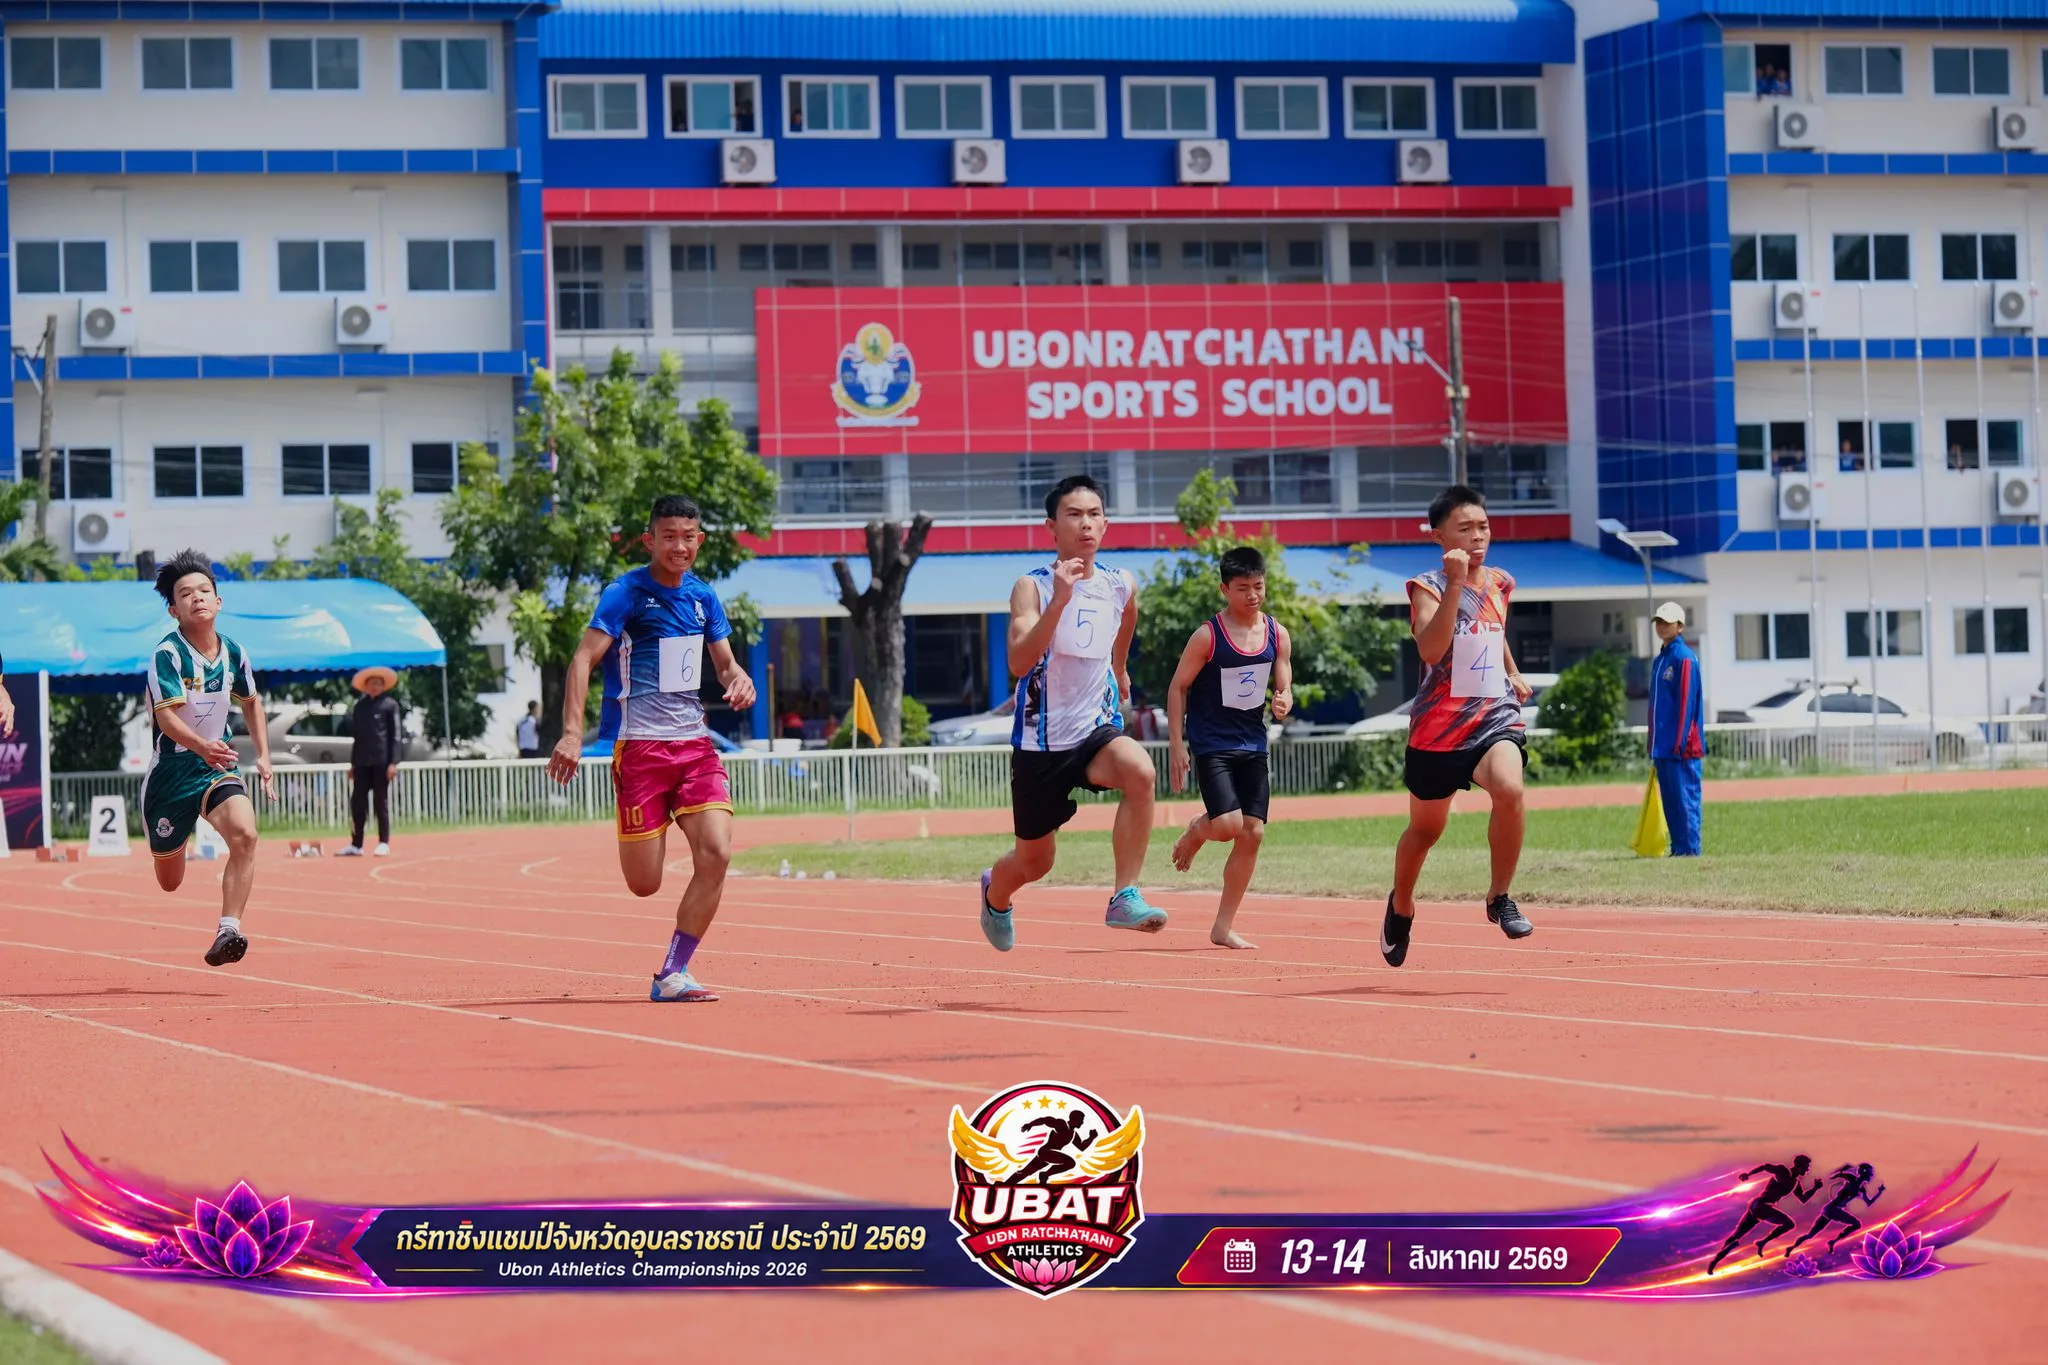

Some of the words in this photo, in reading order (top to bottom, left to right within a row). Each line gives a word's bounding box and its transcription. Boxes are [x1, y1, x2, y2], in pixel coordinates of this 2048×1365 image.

[972, 326, 1425, 368] UBONRATCHATHANI
[1027, 379, 1199, 419] SPORTS
[1221, 377, 1392, 416] SCHOOL
[1075, 608, 1097, 649] 5
[681, 648, 695, 682] 6
[1470, 644, 1494, 682] 4
[1237, 671, 1257, 698] 3
[194, 701, 217, 728] 7
[100, 807, 116, 833] 2
[625, 806, 644, 826] 10
